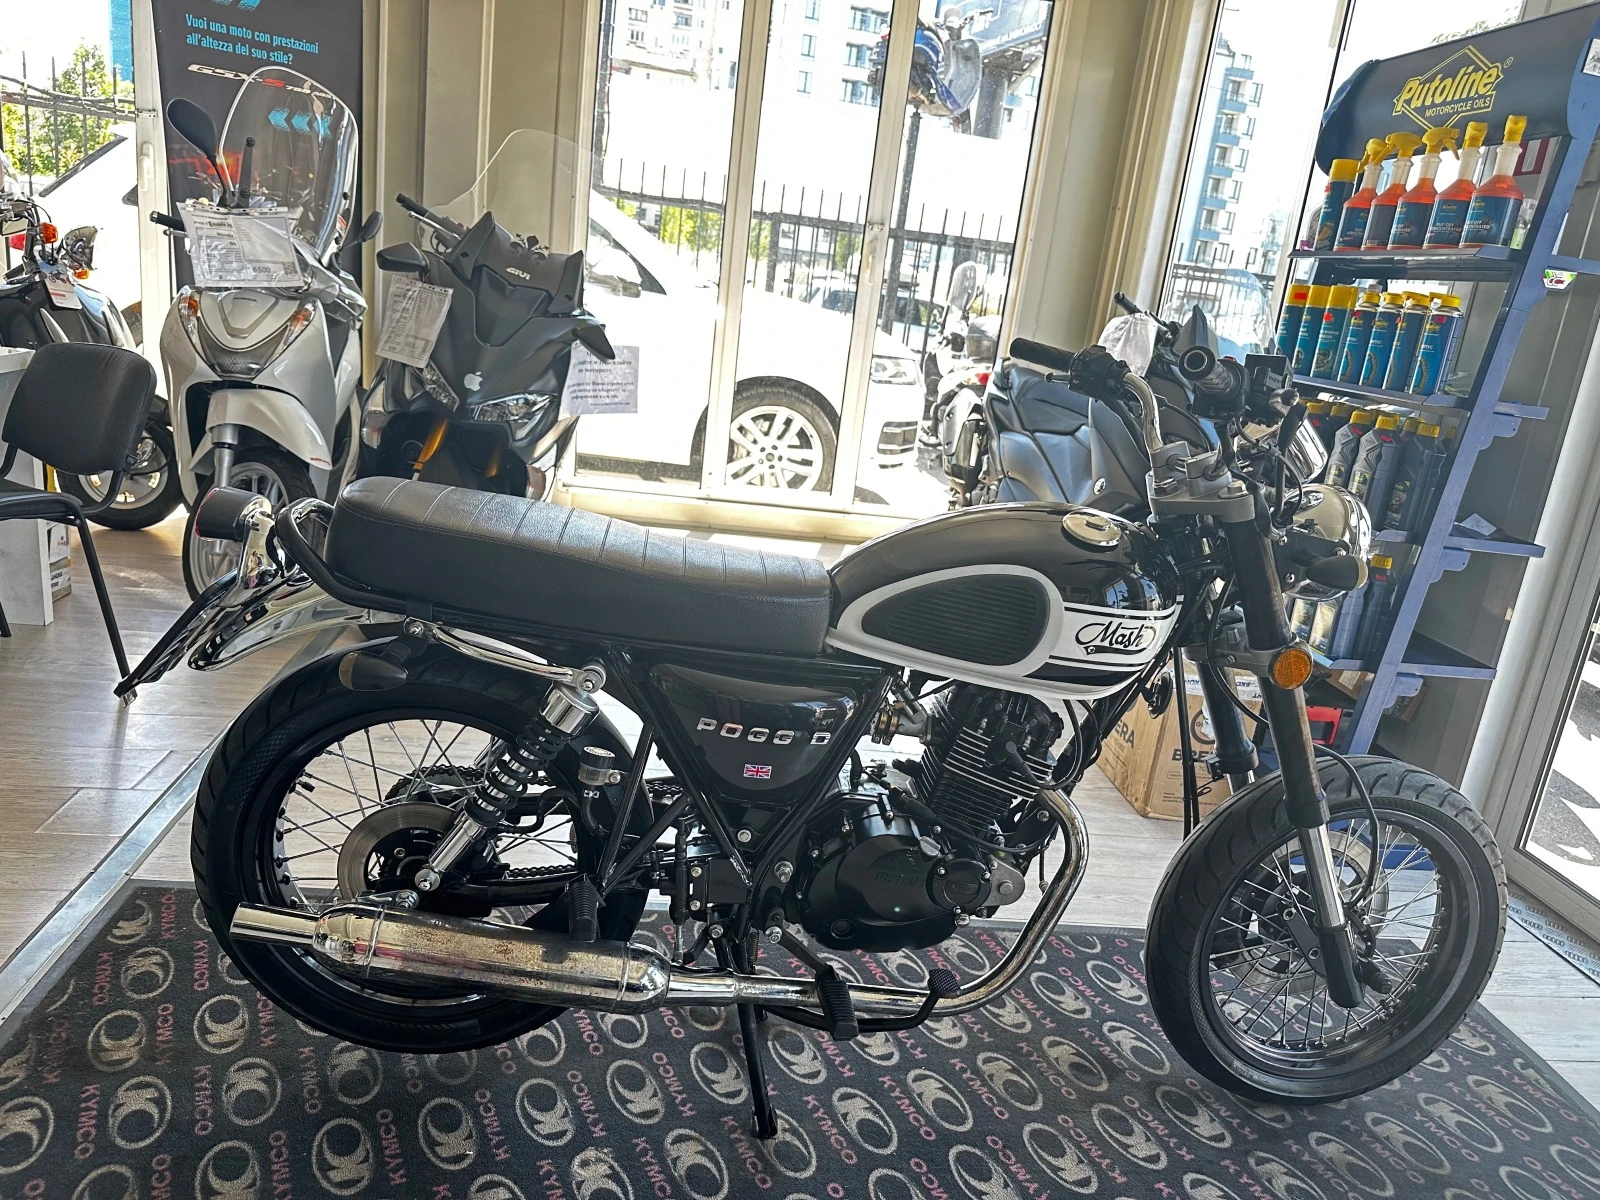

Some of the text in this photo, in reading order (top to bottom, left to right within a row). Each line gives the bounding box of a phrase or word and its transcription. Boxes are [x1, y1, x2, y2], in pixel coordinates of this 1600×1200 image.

[185, 13, 319, 54] Vuoi una moto con prestazioni
[186, 33, 293, 65] all'altezza del suo stile?
[1394, 65, 1499, 114] Putoline
[1424, 97, 1491, 118] MOTORCYCLE OILS
[505, 267, 531, 280] GIVI
[1075, 620, 1148, 649] Mash
[1114, 719, 1135, 749] ERA
[161, 894, 176, 940] KYMCO
[93, 951, 113, 1006] KYMCO
[193, 939, 209, 992] KYMCO
[1058, 966, 1116, 1014] KYMCO
[257, 991, 277, 1047] KYMC
[572, 1008, 604, 1056] YMCO
[660, 1007, 685, 1039] MCO
[961, 1013, 994, 1042] KYM
[1011, 987, 1057, 1028] KYMC
[298, 1047, 322, 1114] KYMCO
[813, 1028, 856, 1077] KYMC
[1016, 1041, 1077, 1100] KYMCO
[1078, 1027, 1141, 1082] KYMCO
[194, 1065, 214, 1136] KYMCO
[567, 1070, 607, 1137] KYMCO
[652, 1052, 696, 1117] KYMCO
[878, 1075, 936, 1141] KYMCO
[950, 1058, 1009, 1120] KYMCO
[1493, 1064, 1579, 1122] KYMCO
[74, 1084, 100, 1160] KYMCO
[376, 1109, 407, 1186] KYMCO
[475, 1088, 511, 1160] KYMCO
[803, 1095, 858, 1164] KYMCO
[1057, 1114, 1127, 1183] KYMCO
[1123, 1095, 1194, 1161] KYMCO
[1414, 1111, 1480, 1163] YMCO
[268, 1130, 293, 1200] YMCO
[632, 1137, 675, 1200] KYMC
[720, 1115, 772, 1190] KYMCO
[1342, 1120, 1425, 1184] KYMCO
